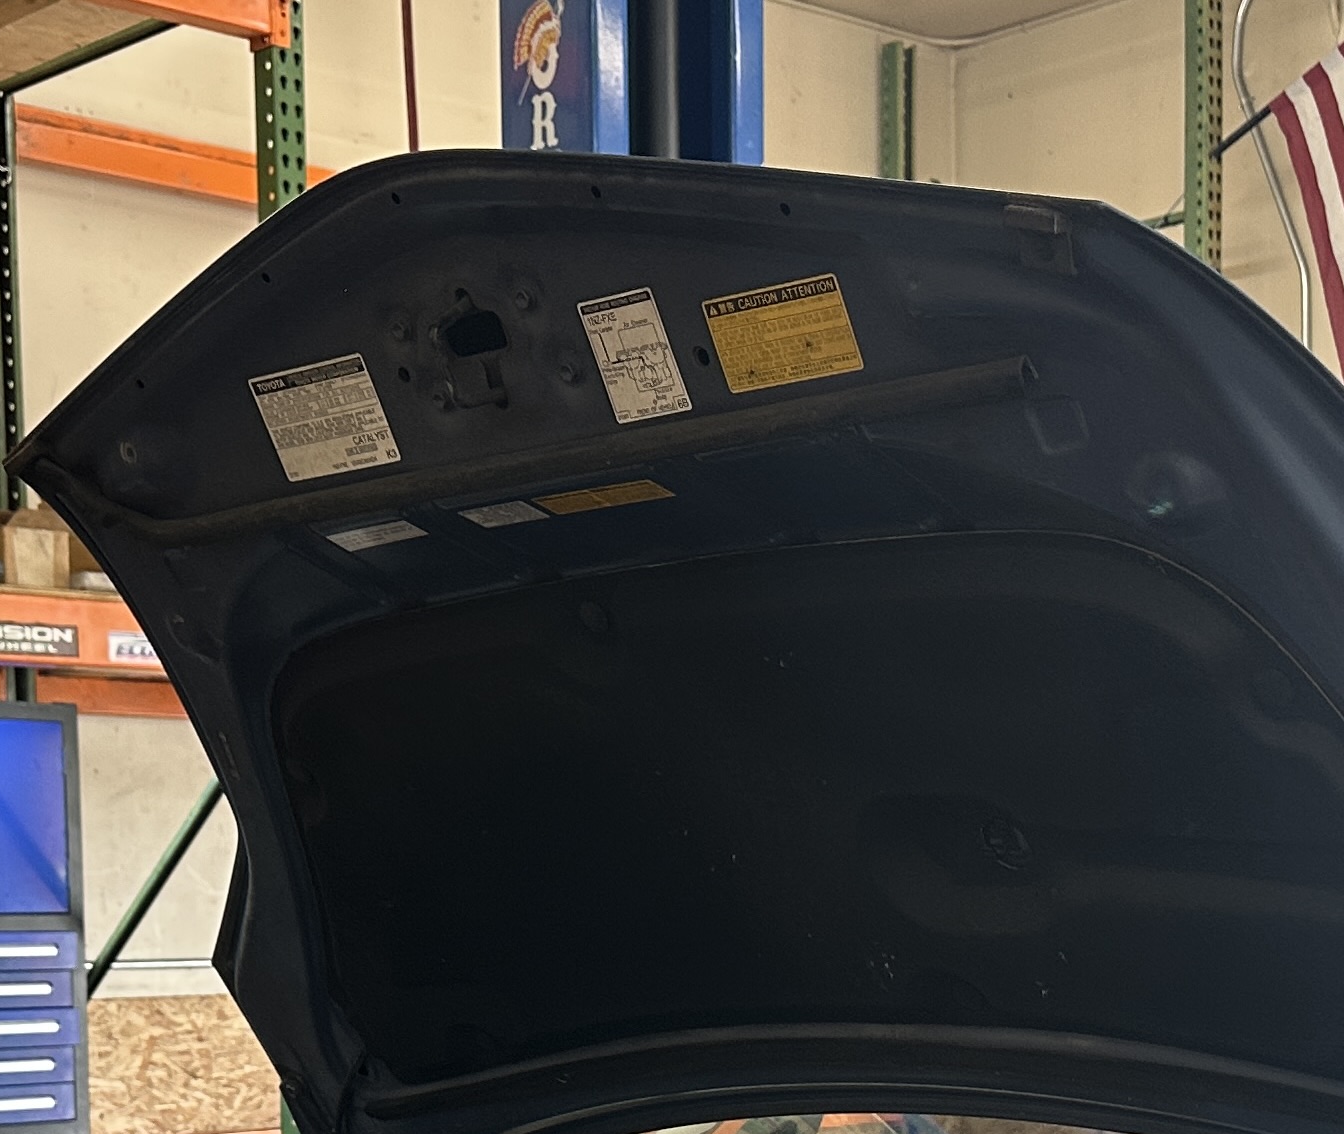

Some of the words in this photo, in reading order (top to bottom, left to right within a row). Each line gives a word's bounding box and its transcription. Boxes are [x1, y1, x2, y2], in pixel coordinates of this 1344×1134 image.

[738, 292, 778, 310] CAUTION
[781, 279, 835, 300] ATTENTION
[256, 379, 287, 393] TOYOTA
[352, 429, 390, 446] CATALYST
